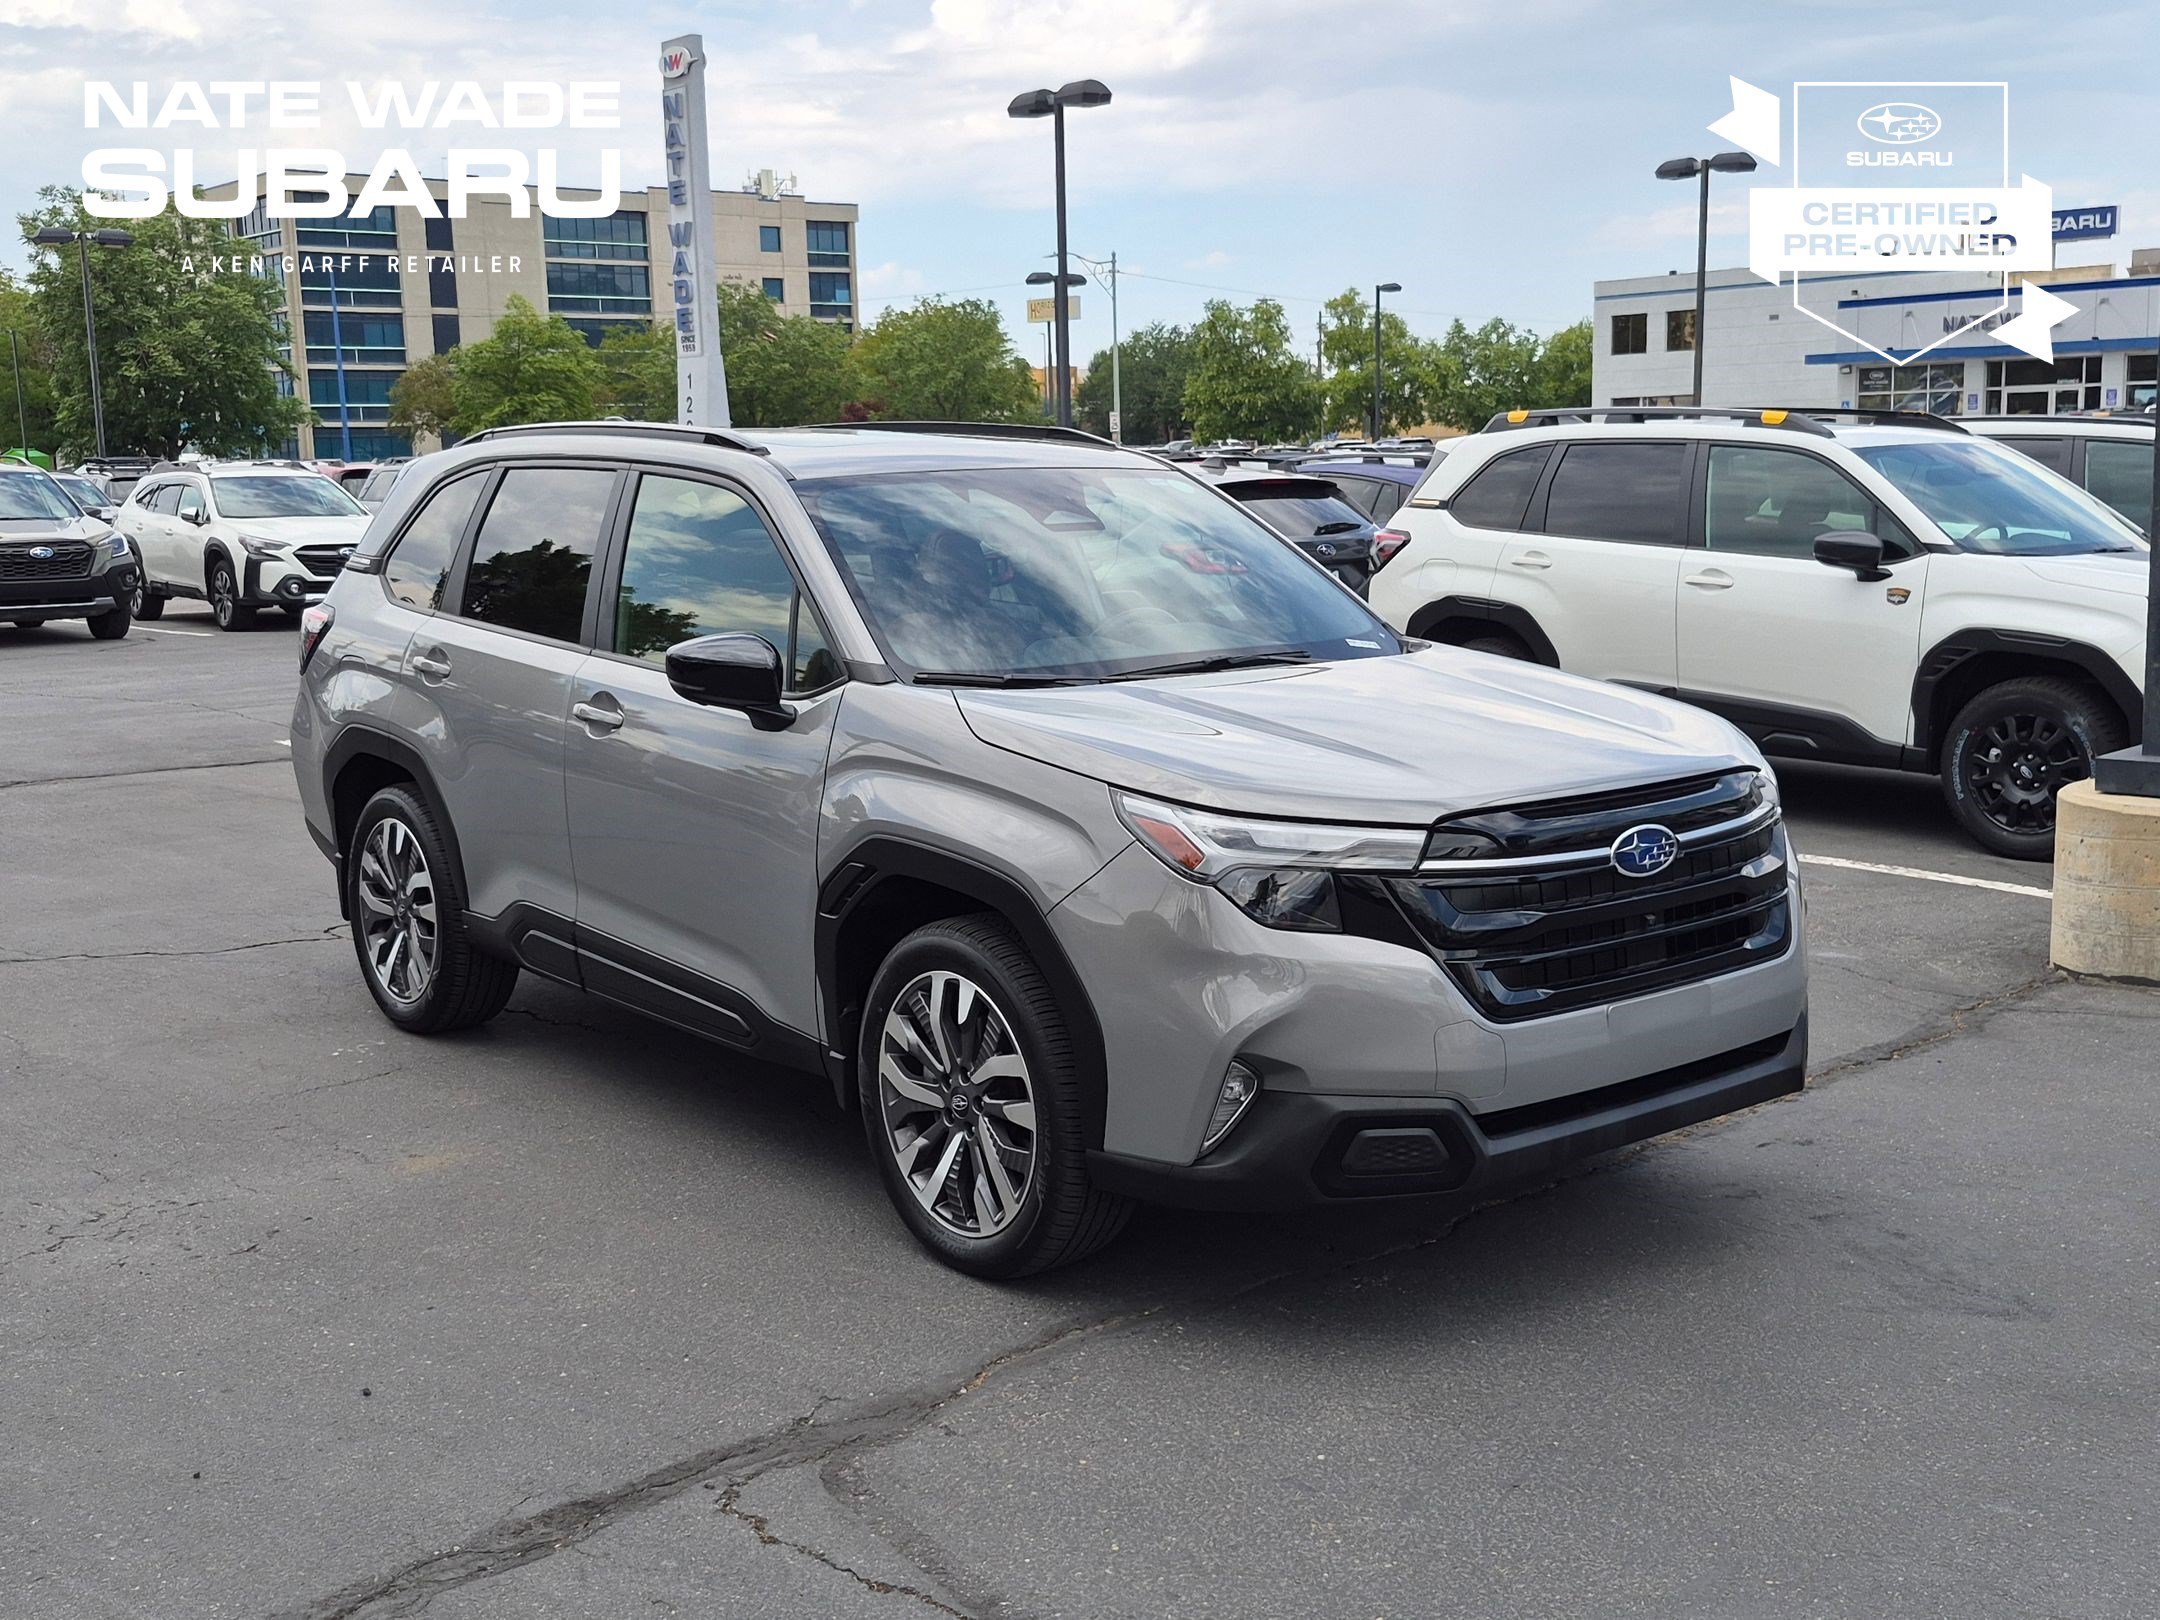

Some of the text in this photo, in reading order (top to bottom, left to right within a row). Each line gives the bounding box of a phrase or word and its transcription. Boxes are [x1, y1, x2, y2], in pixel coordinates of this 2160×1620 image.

[663, 51, 683, 73] NW
[663, 92, 694, 333] NATE WADE
[2051, 212, 2112, 232] BARU
